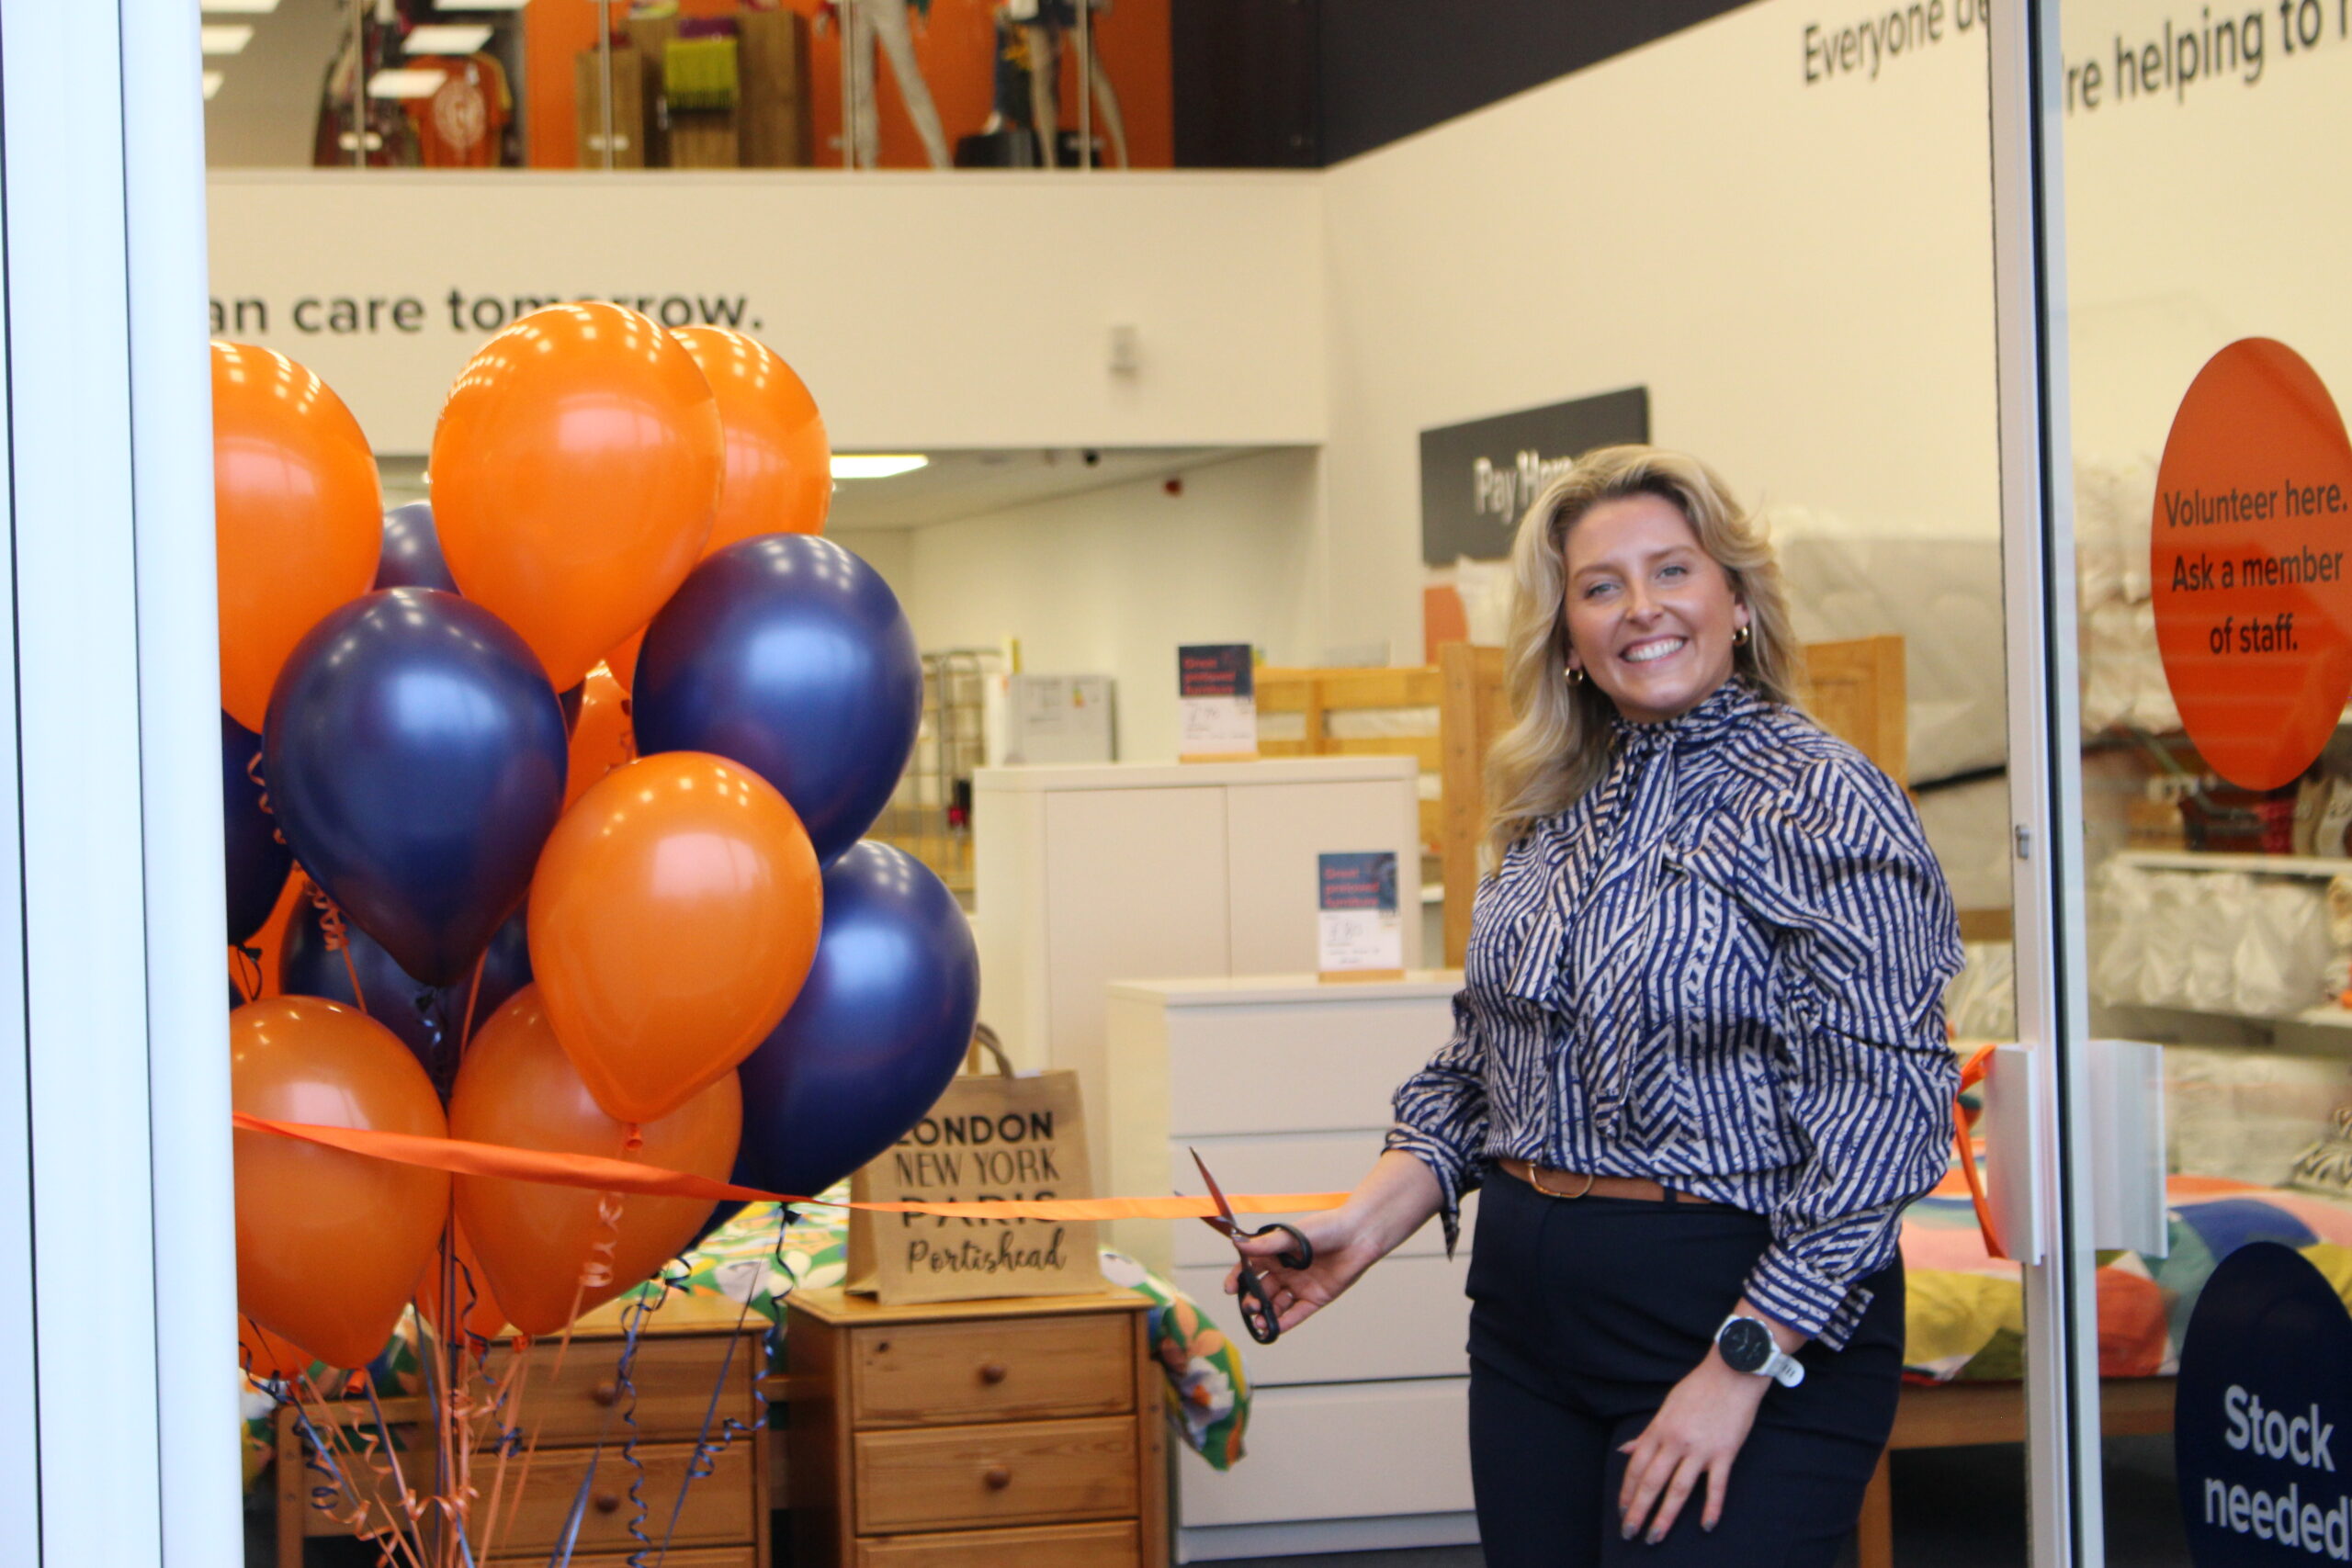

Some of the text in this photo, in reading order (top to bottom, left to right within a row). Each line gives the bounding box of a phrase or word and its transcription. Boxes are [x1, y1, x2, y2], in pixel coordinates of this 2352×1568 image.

[1803, 0, 1943, 88] Everyone
[2115, 9, 2267, 104] helping
[2278, 0, 2323, 53] to
[291, 295, 425, 335] care
[1474, 457, 1517, 525] Pay
[2164, 479, 2348, 528] Volunteer here.
[2172, 545, 2344, 592] Ask a member
[2210, 613, 2299, 655] of staff.
[895, 1147, 1061, 1188] NEW YORK
[906, 1226, 1067, 1275] Portishead
[2223, 1383, 2335, 1472] Stock
[2205, 1477, 2352, 1562] needed
